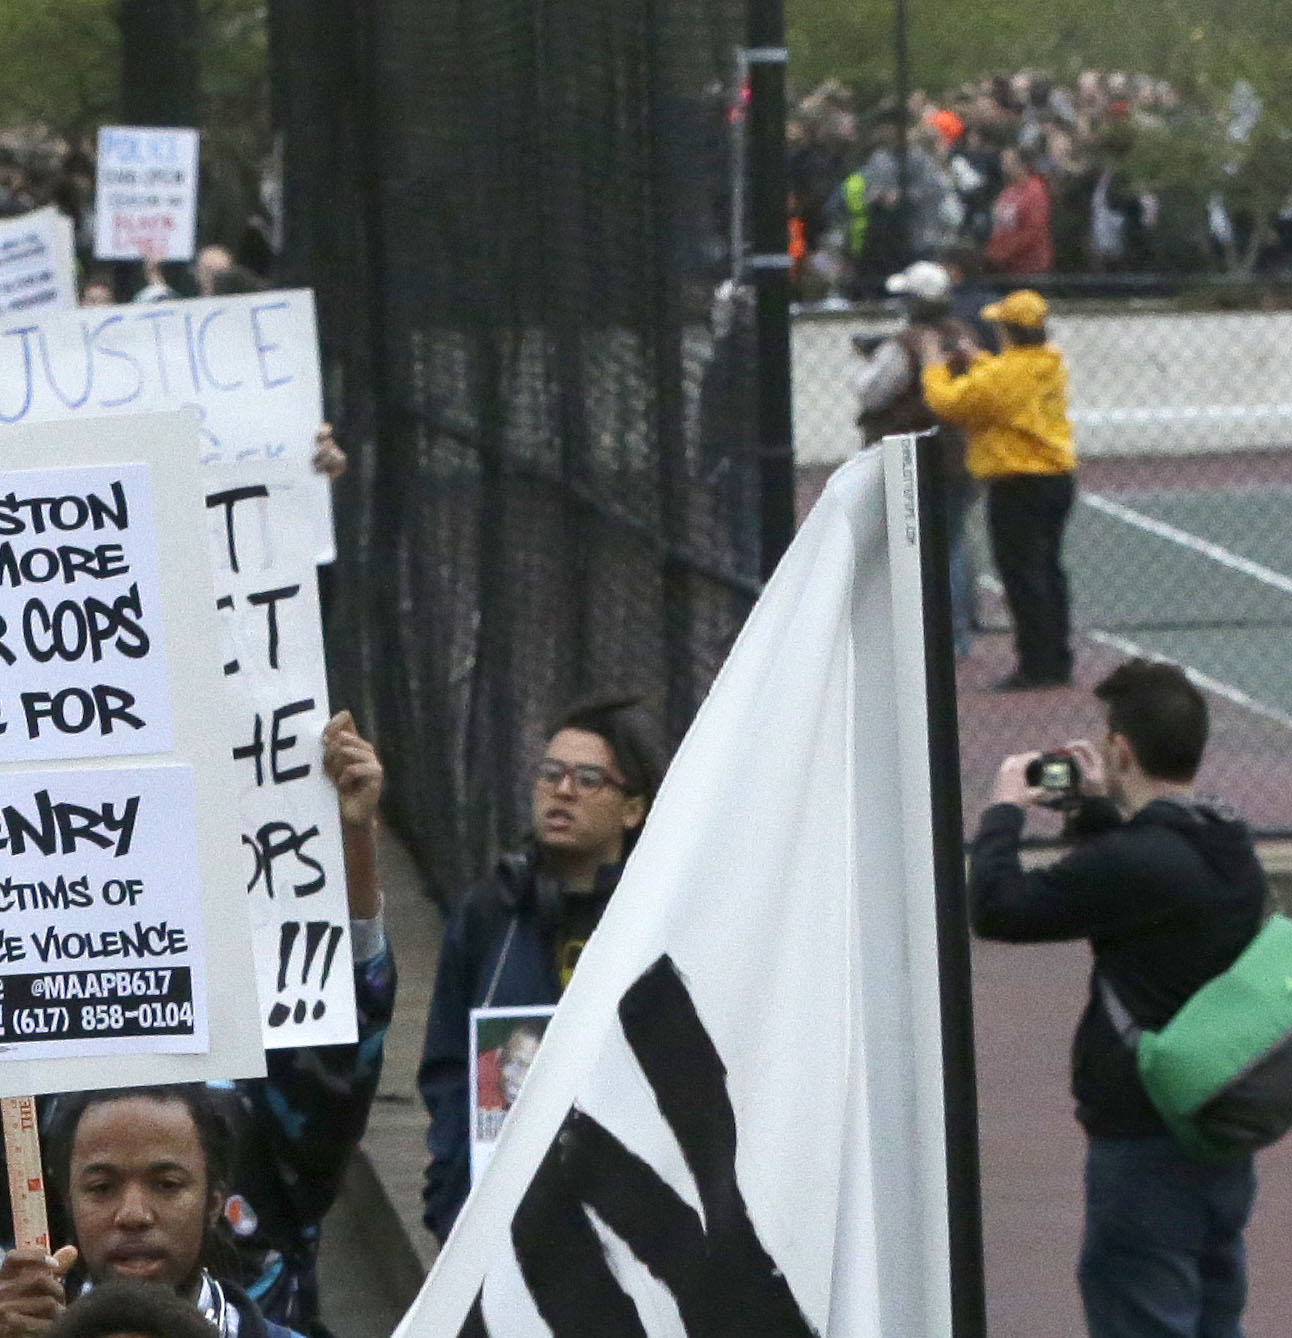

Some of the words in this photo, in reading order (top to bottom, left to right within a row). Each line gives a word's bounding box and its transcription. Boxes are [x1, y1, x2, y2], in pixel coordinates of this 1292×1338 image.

[22, 581, 150, 663] COPS
[20, 684, 147, 740] FOR
[102, 879, 144, 907] OF
[30, 921, 189, 963] VIOLENCE
[29, 968, 172, 1000] @MAAPB617
[12, 1007, 70, 1035] (617)
[81, 1001, 194, 1031] 858-0104
